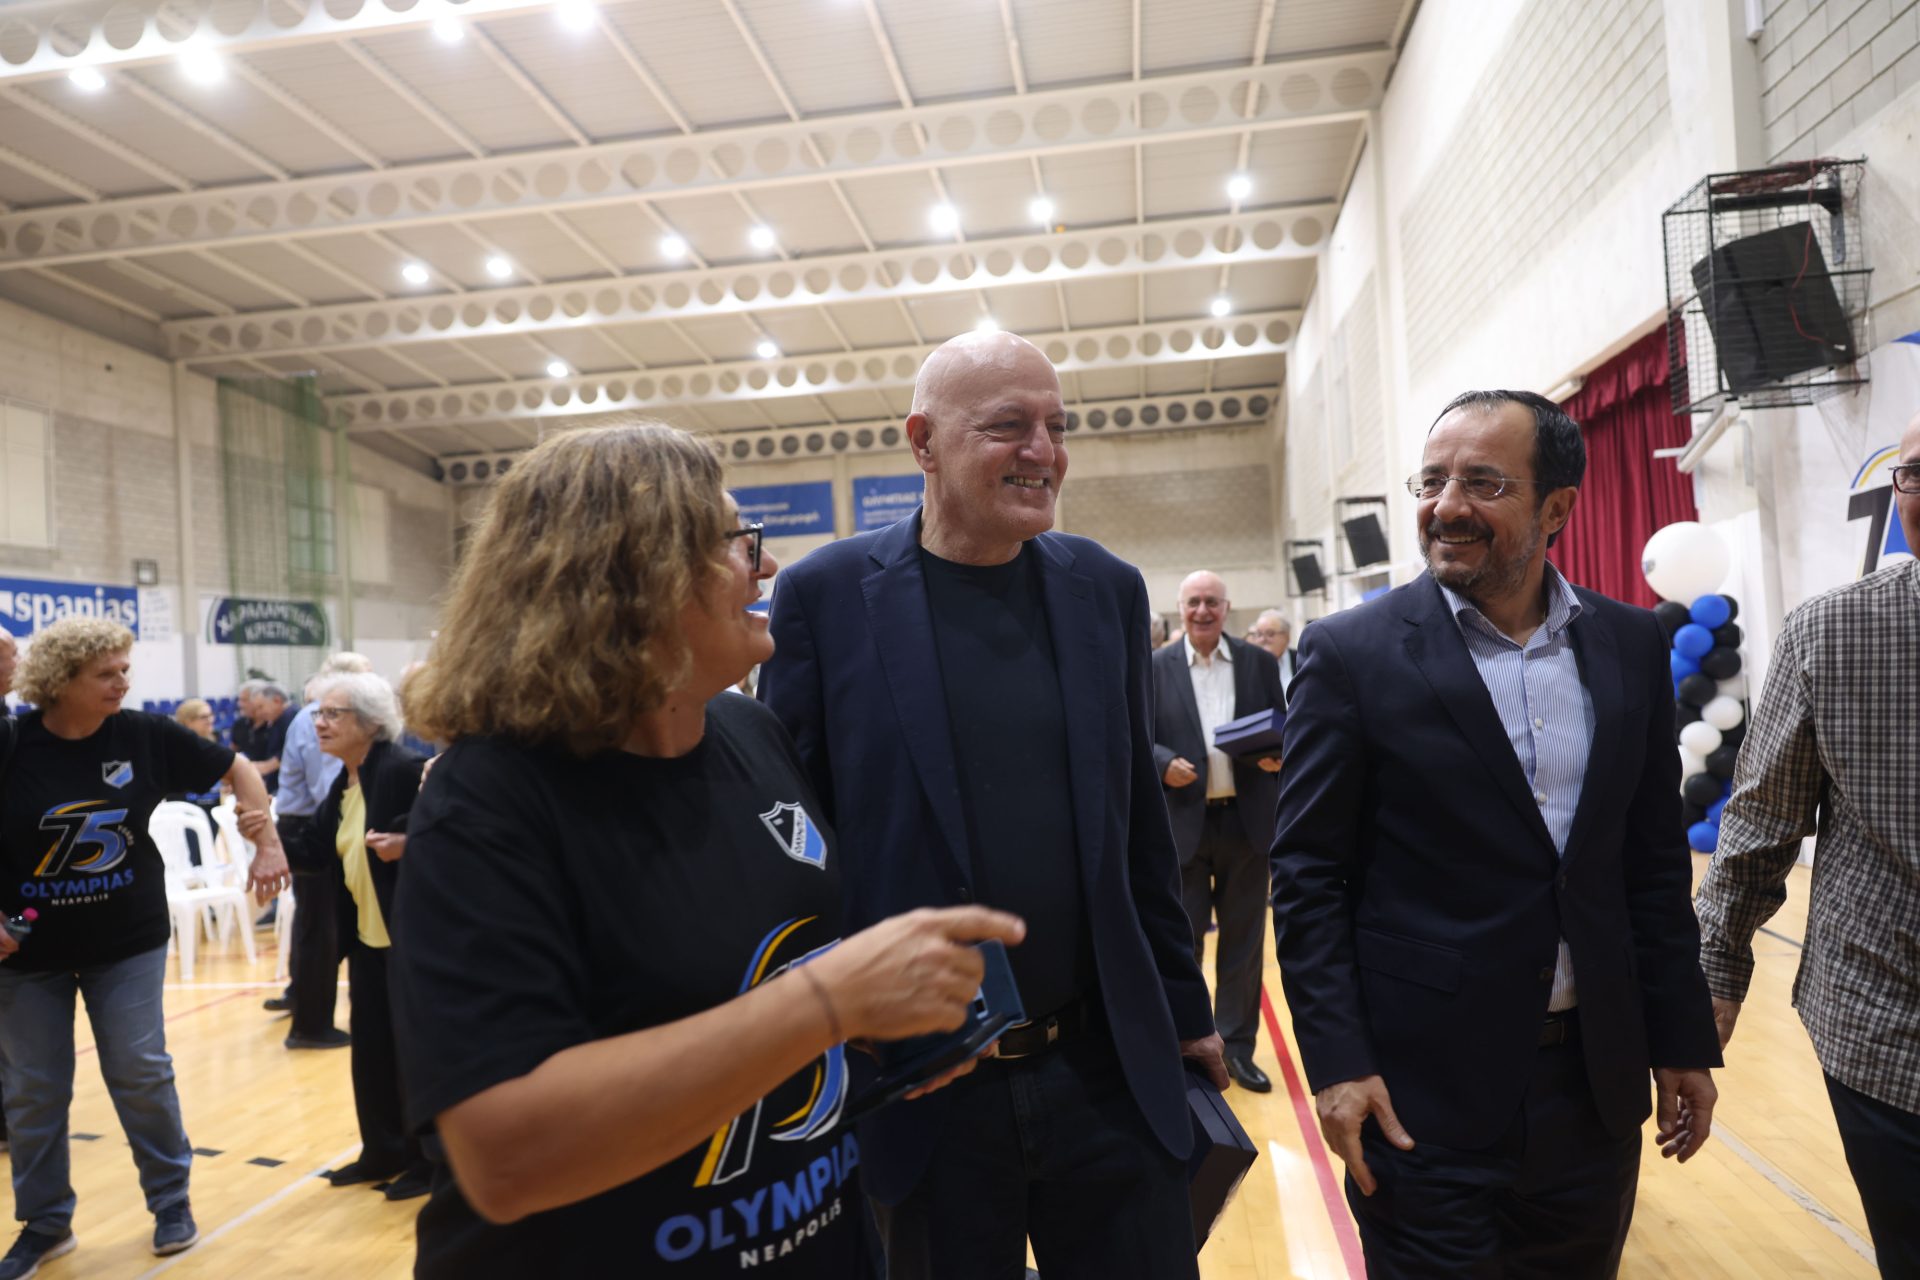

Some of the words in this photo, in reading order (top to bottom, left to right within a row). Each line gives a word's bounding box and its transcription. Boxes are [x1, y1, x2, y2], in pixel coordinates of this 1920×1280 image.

[14, 586, 138, 633] spanias
[39, 808, 128, 877] 75
[20, 868, 134, 898] OLYMPIAS
[51, 893, 109, 906] NEAPOLIS
[740, 1197, 842, 1269] NEAPOLIS
